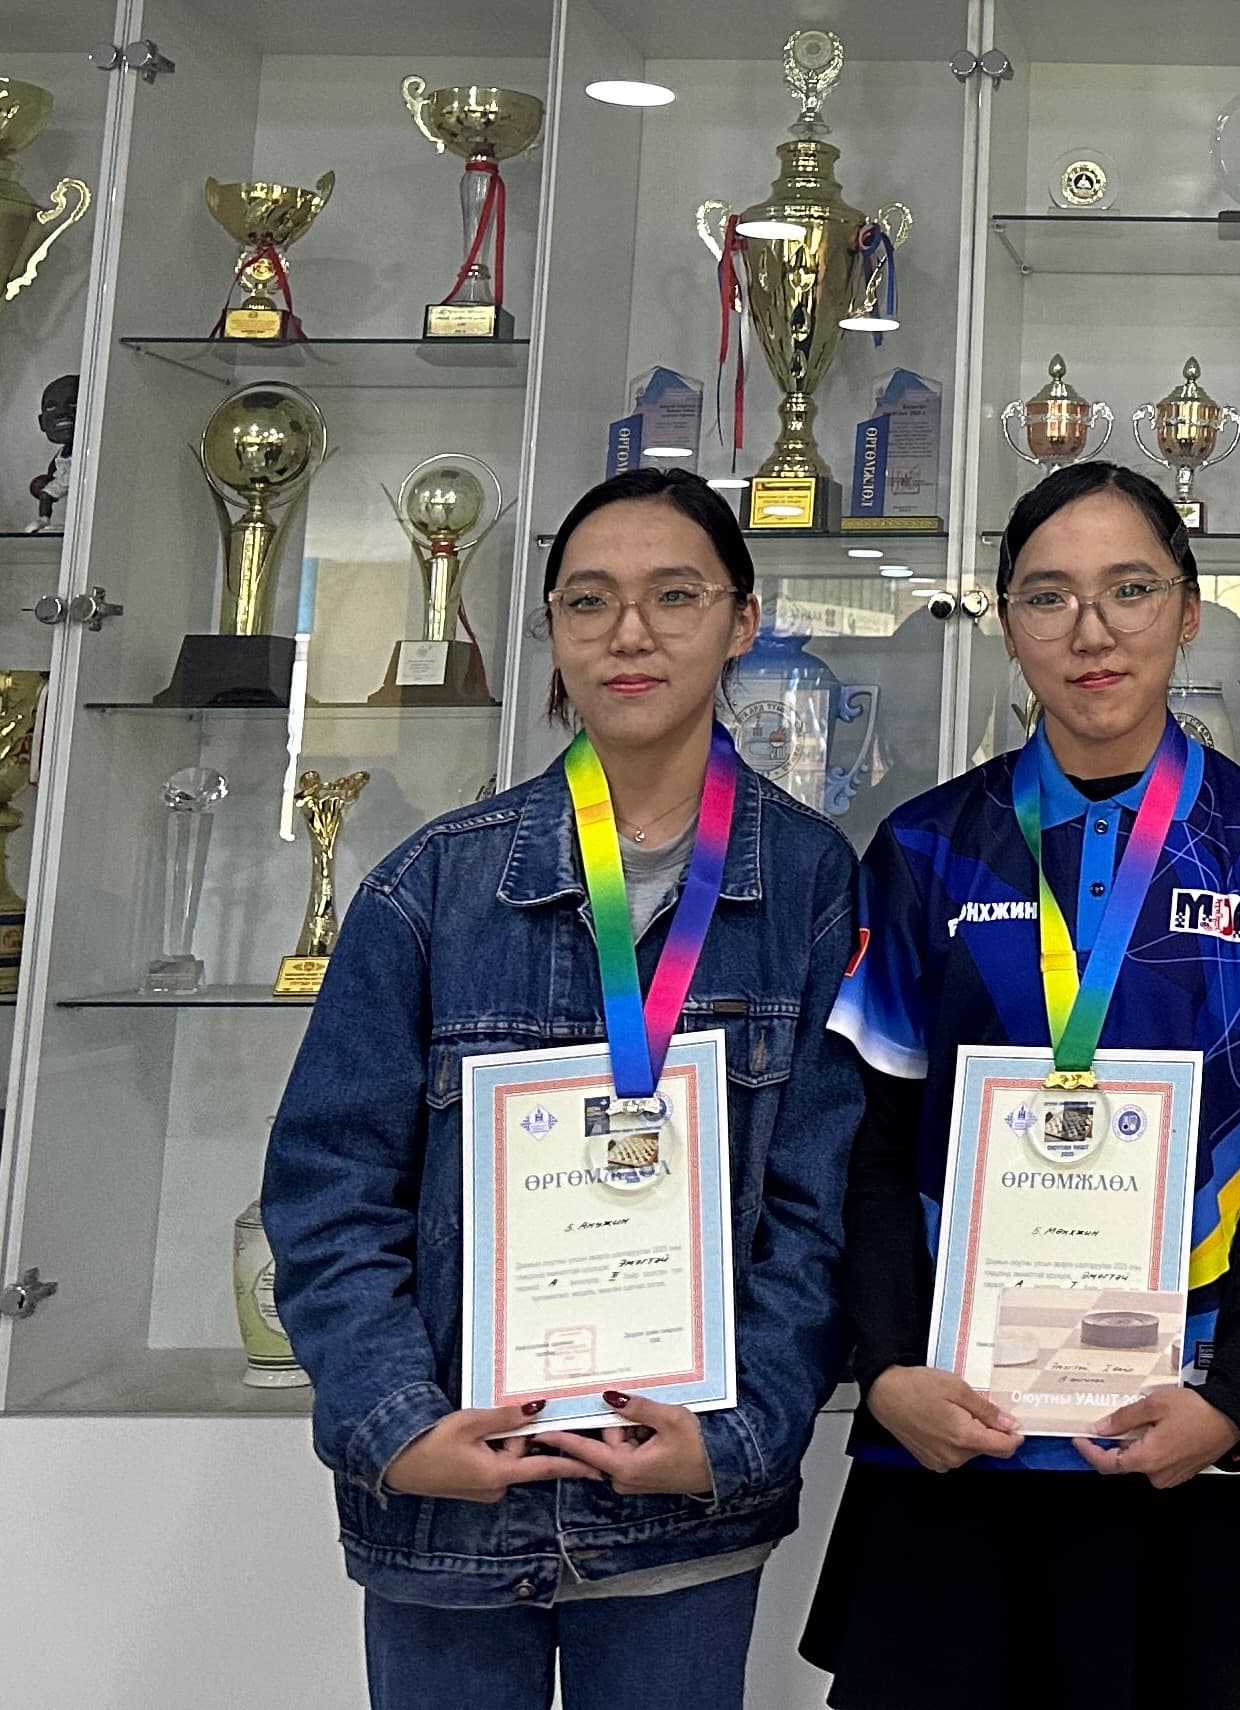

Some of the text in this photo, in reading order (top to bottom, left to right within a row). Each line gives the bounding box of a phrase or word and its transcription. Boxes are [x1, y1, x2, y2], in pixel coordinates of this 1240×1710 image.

[1001, 1171, 1139, 1192] ӨРГӨМЖЛӨЛ
[1011, 1391, 1073, 1407] Оюутны
[1075, 1391, 1119, 1406] УАШТ
